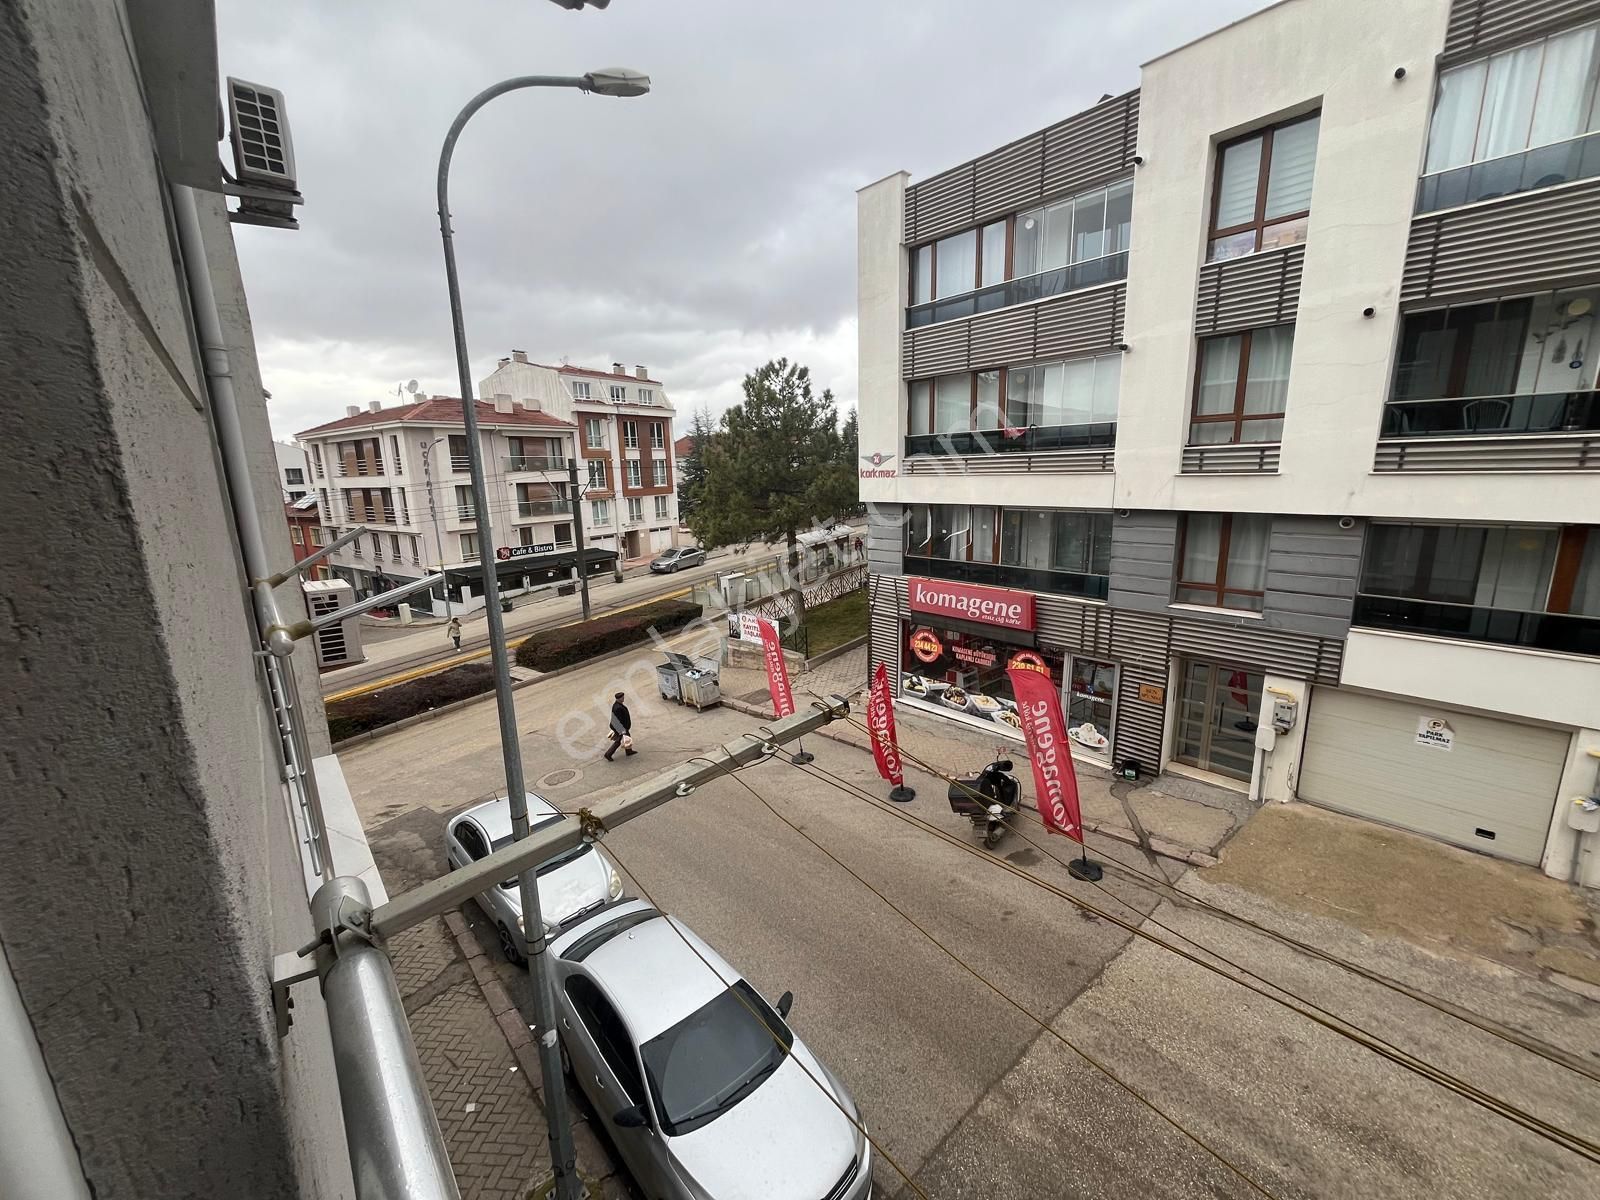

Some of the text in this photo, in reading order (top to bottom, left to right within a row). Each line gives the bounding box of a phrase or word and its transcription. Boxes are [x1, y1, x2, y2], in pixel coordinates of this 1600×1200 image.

[860, 467, 896, 478] korkmaz
[512, 547, 527, 556] Cafe
[527, 546, 533, 554] &
[534, 545, 553, 553] Bistro
[916, 583, 1022, 618] komagene
[1076, 691, 1105, 703] komagene
[1418, 733, 1450, 744] YAPILMAZ
[1426, 730, 1443, 738] PARK
